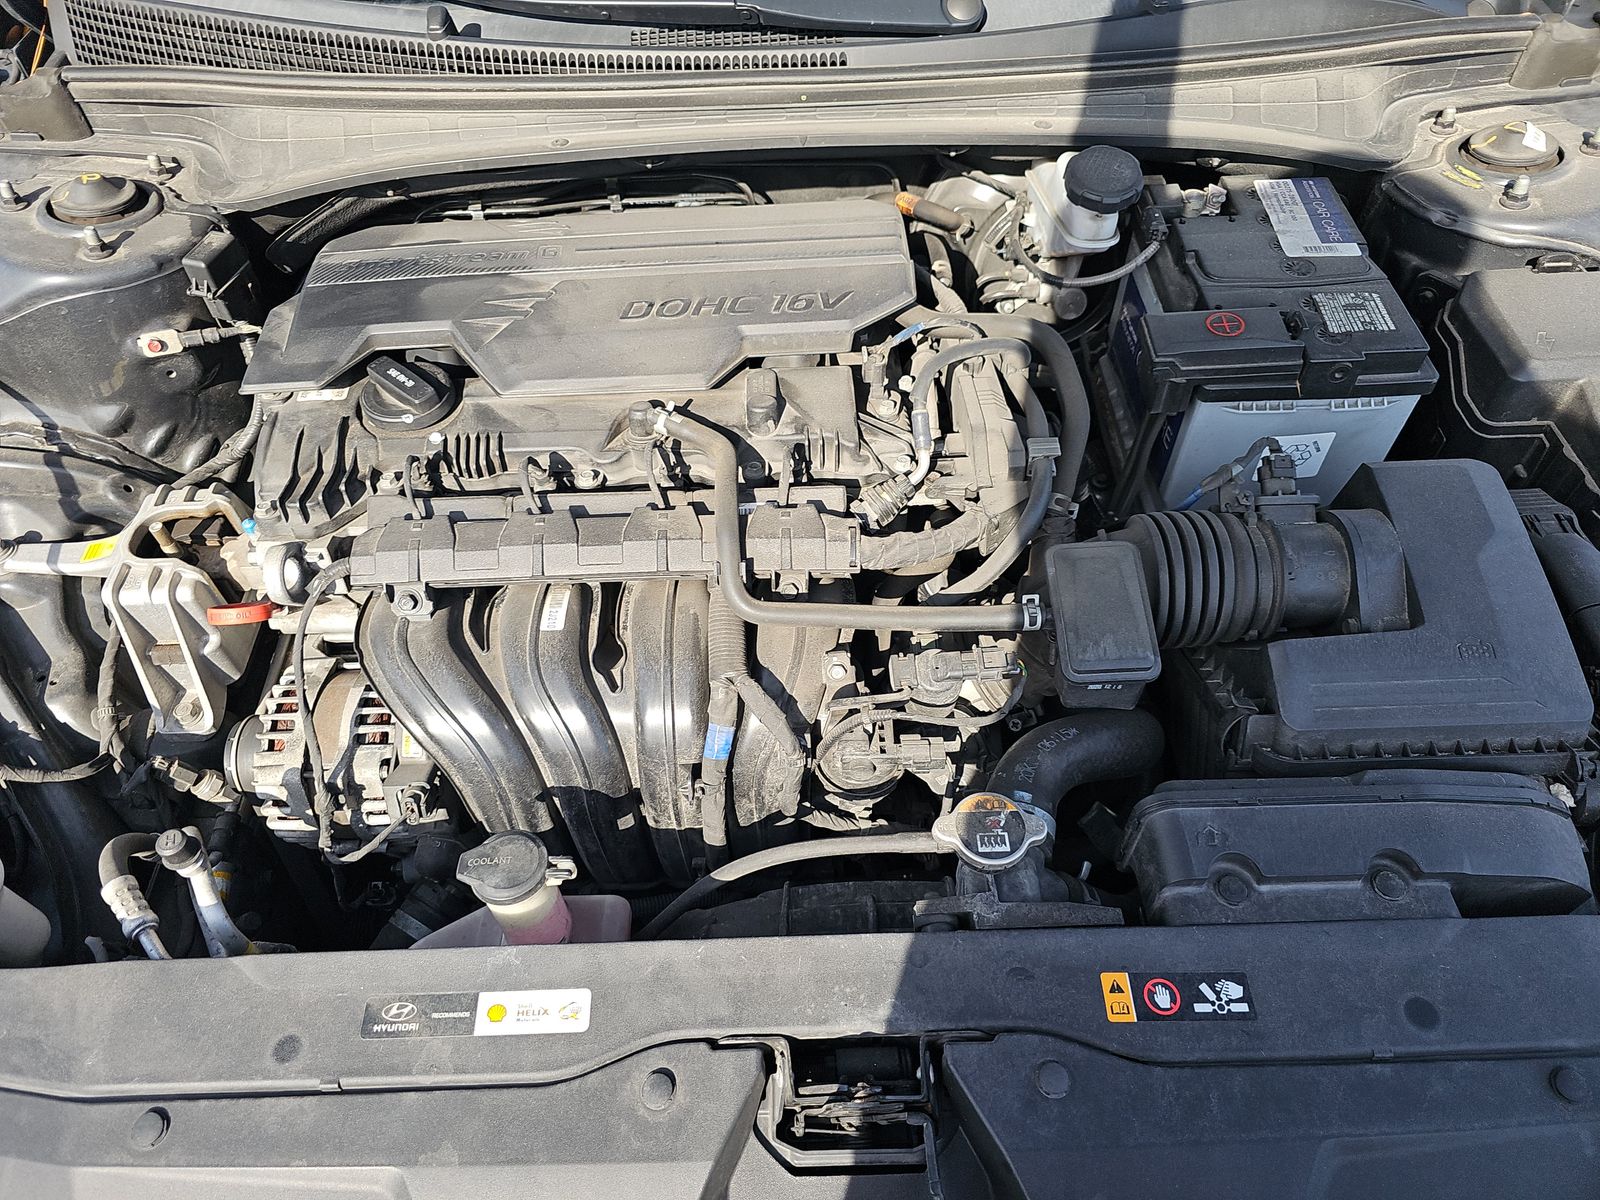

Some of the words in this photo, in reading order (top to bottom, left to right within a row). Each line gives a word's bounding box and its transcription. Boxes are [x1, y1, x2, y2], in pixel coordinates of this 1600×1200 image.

[1313, 201, 1330, 217] CAR
[1322, 219, 1343, 242] CARE
[619, 295, 761, 321] DOHC
[771, 290, 854, 314] 16V
[467, 856, 512, 867] COOLANT
[516, 1007, 549, 1017] HELIX
[373, 1022, 420, 1033] HYUNDAI
